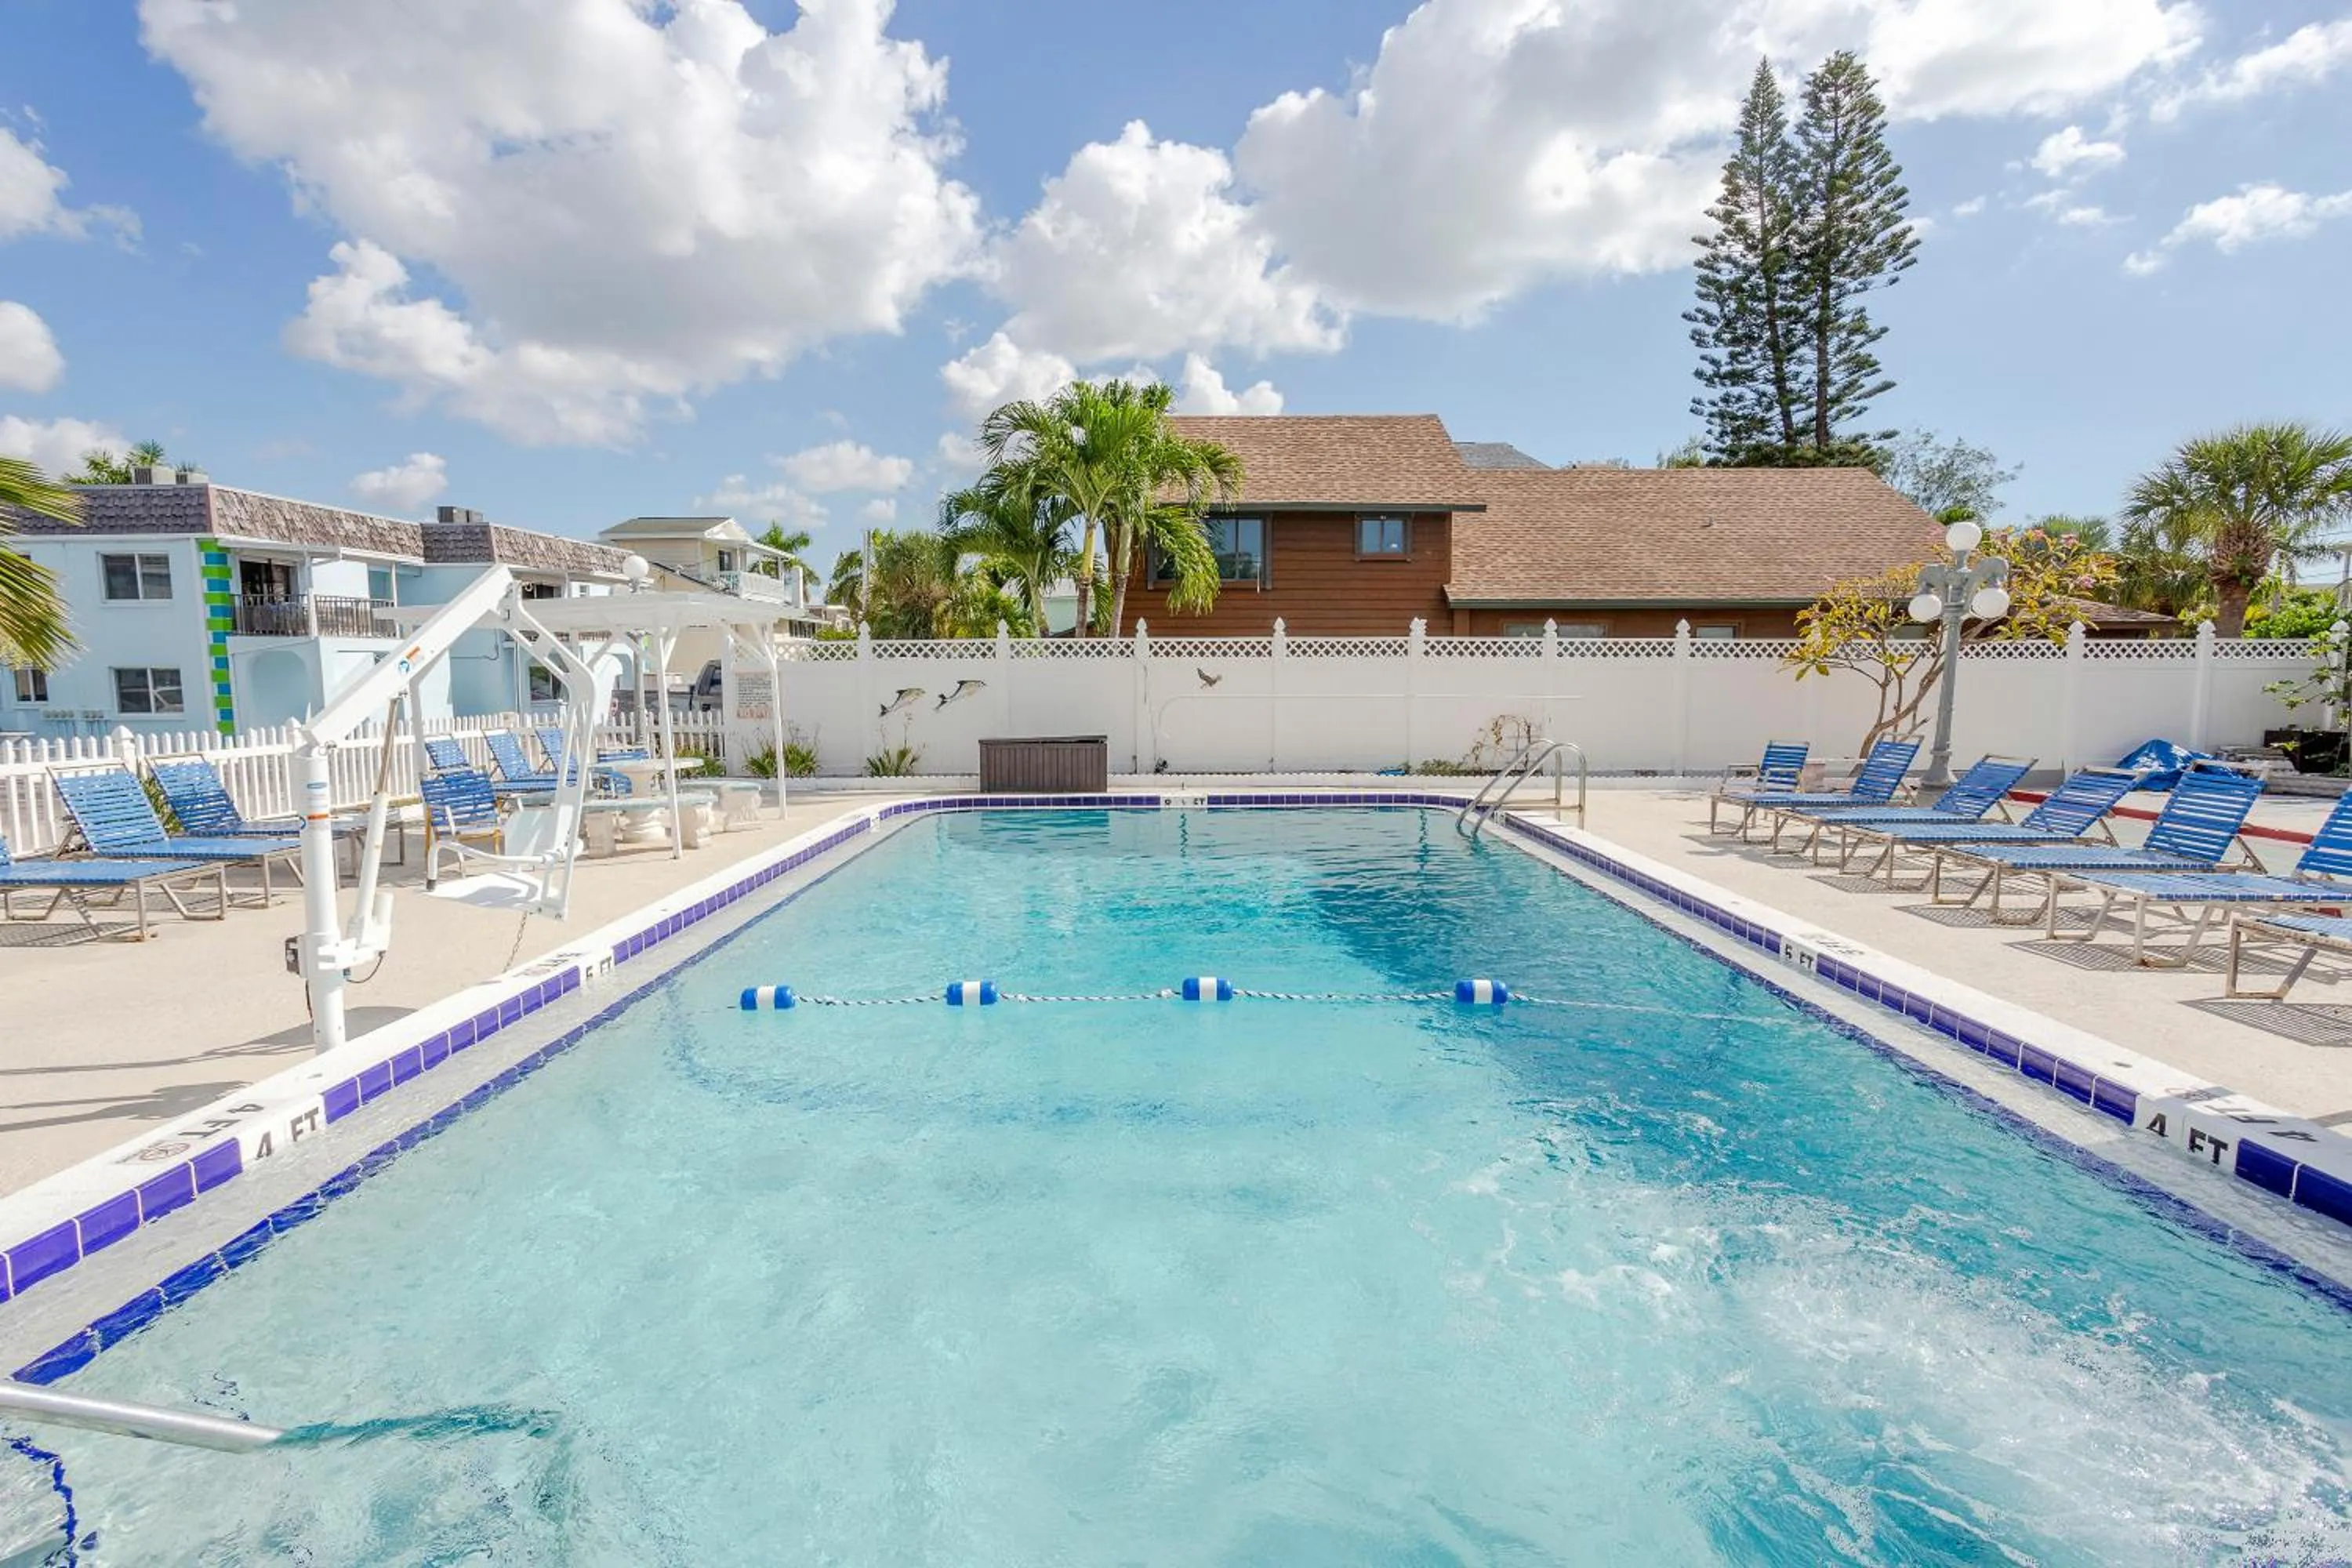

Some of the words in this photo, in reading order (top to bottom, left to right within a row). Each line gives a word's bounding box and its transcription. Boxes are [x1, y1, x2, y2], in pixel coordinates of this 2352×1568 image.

[599, 956, 612, 974] FT
[1785, 943, 1793, 960] 5
[1799, 950, 1813, 969] FT
[255, 1131, 273, 1160] 4
[289, 1106, 319, 1142] FT
[2146, 1112, 2169, 1138] 4
[2188, 1127, 2229, 1165] FT
